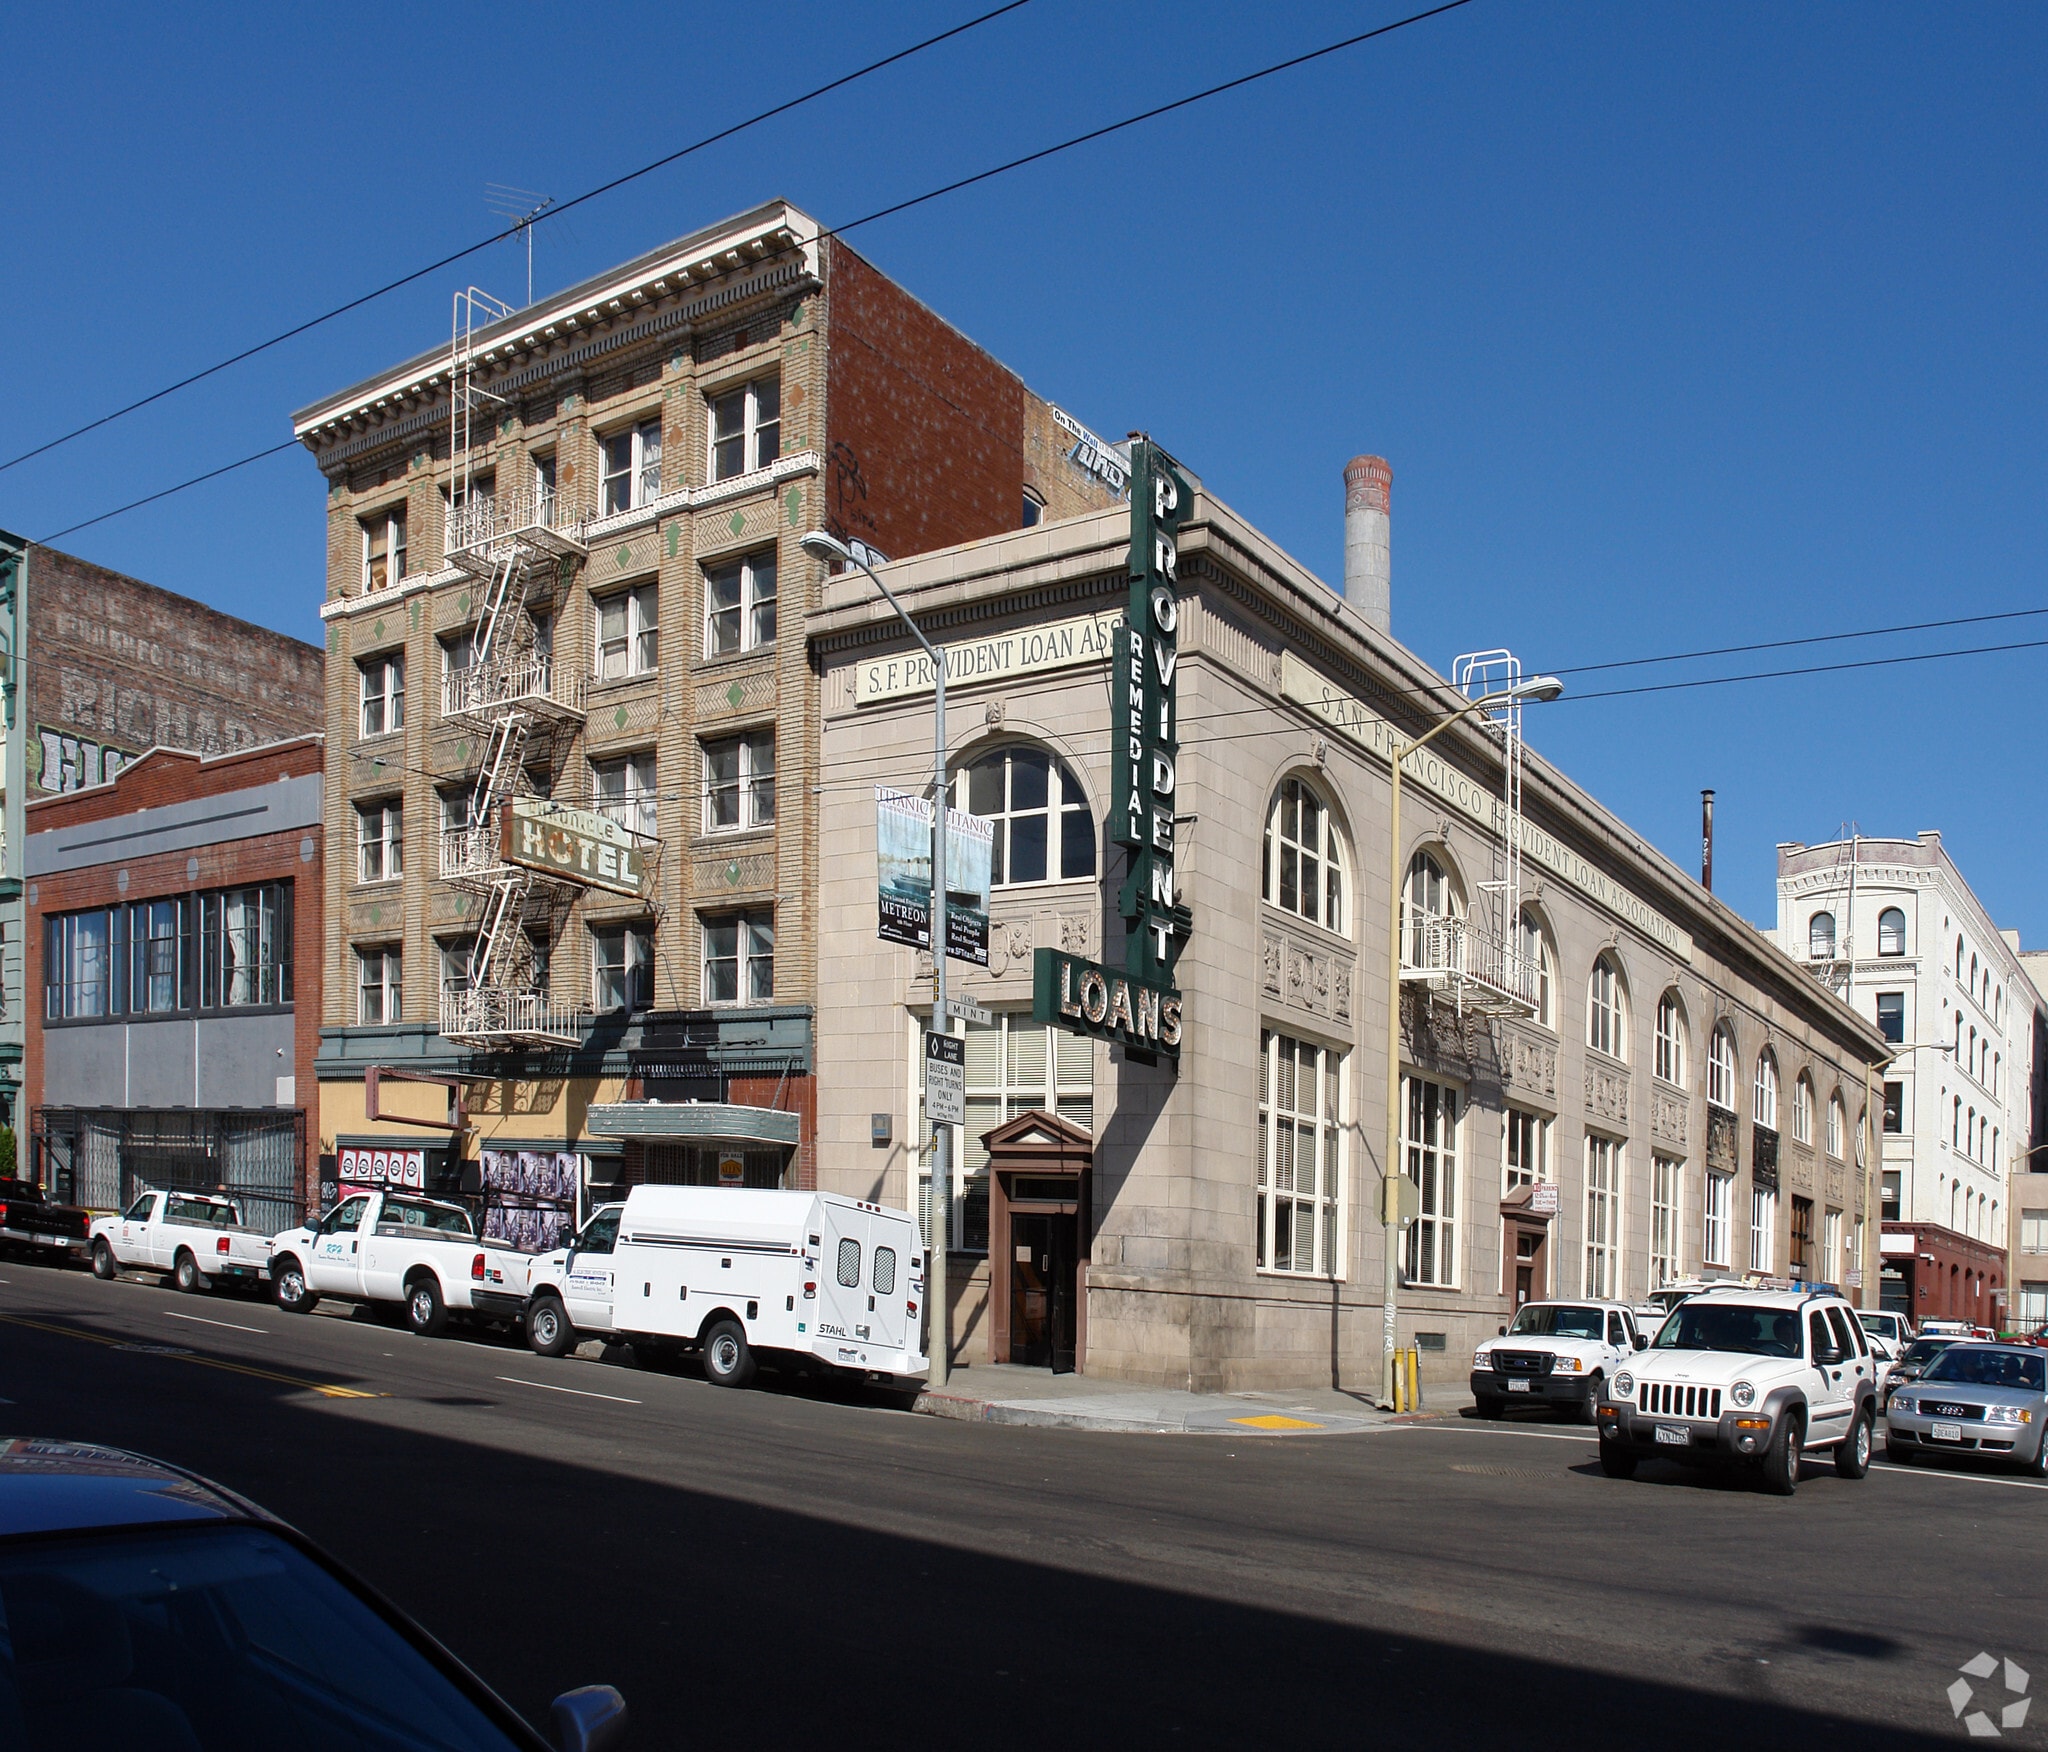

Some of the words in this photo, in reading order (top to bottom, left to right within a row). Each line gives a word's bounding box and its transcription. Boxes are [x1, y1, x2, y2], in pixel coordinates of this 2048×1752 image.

[1054, 410, 1066, 426] On
[1067, 418, 1081, 436] The
[1083, 430, 1098, 448] Wall
[1021, 628, 1073, 665] LOAN
[1150, 472, 1178, 961] PROVIDENT
[1128, 630, 1145, 840] REMEDIAL
[877, 788, 929, 815] TITANIC
[945, 809, 992, 836] TITANIC
[1321, 686, 1362, 736] SAN
[1374, 725, 1482, 814] FRANCISCO
[1491, 800, 1570, 874] PROVIDENT
[1574, 859, 1605, 899] LOAN
[1611, 888, 1679, 949] ASSOCIATION
[522, 820, 639, 885] HOTEL
[881, 900, 927, 924] METREON
[951, 911, 963, 921] Real
[951, 922, 963, 932] Real
[951, 932, 963, 942] Real
[953, 1004, 985, 1021] MINT
[1059, 961, 1182, 1046] LOANS
[943, 1040, 959, 1051] RIGHT
[944, 1050, 958, 1061] LANE
[929, 1062, 948, 1075] BUSES
[950, 1067, 961, 1078] AND
[929, 1075, 944, 1087] RIGHT
[944, 1077, 962, 1091] TURNS
[937, 1089, 954, 1102] ONLY
[819, 1323, 847, 1337] STAHL
